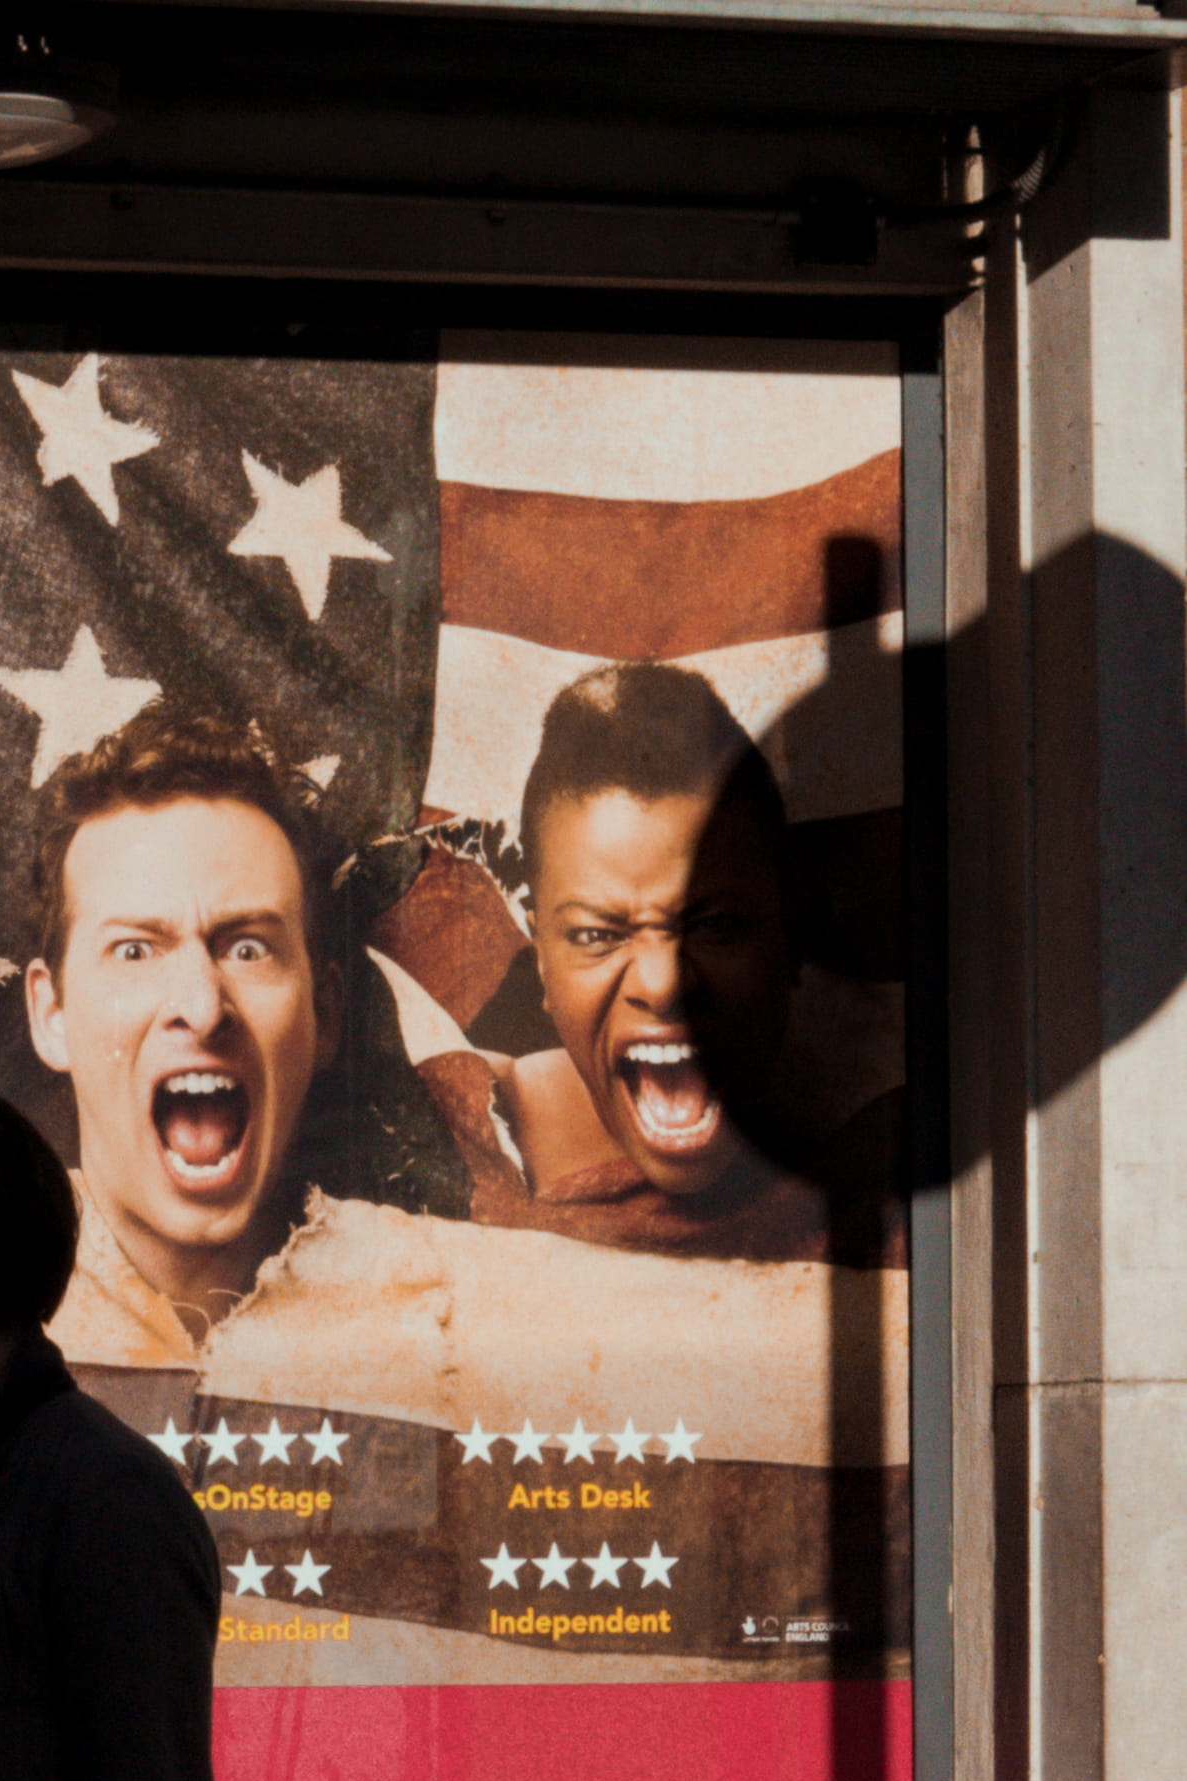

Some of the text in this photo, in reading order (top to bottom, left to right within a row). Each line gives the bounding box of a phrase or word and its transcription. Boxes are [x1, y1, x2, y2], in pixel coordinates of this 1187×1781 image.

[507, 1482, 651, 1511] Arts Desk
[218, 1614, 351, 1643] Standard
[489, 1607, 672, 1640] Independent
